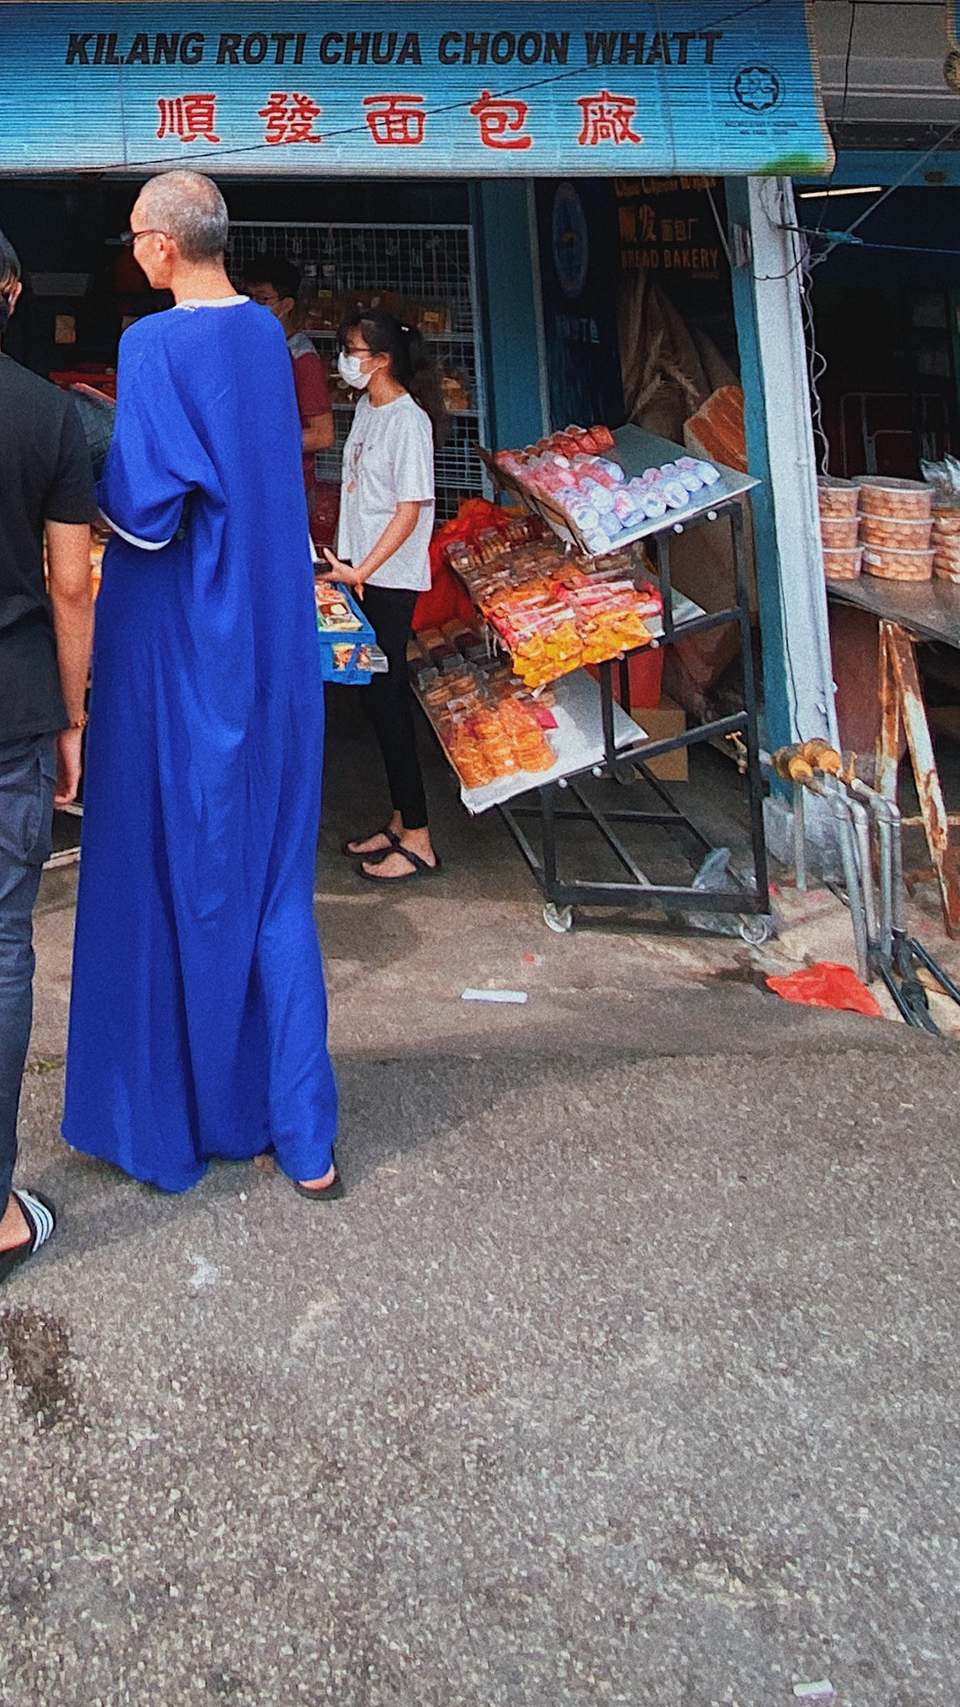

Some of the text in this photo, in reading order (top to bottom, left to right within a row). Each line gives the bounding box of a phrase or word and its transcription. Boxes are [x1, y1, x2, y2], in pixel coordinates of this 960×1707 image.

[65, 30, 724, 66] KILANG ROTI CHUA CHOON WHATT
[155, 89, 642, 149] 順發面包廠
[663, 247, 719, 271] BAKERY
